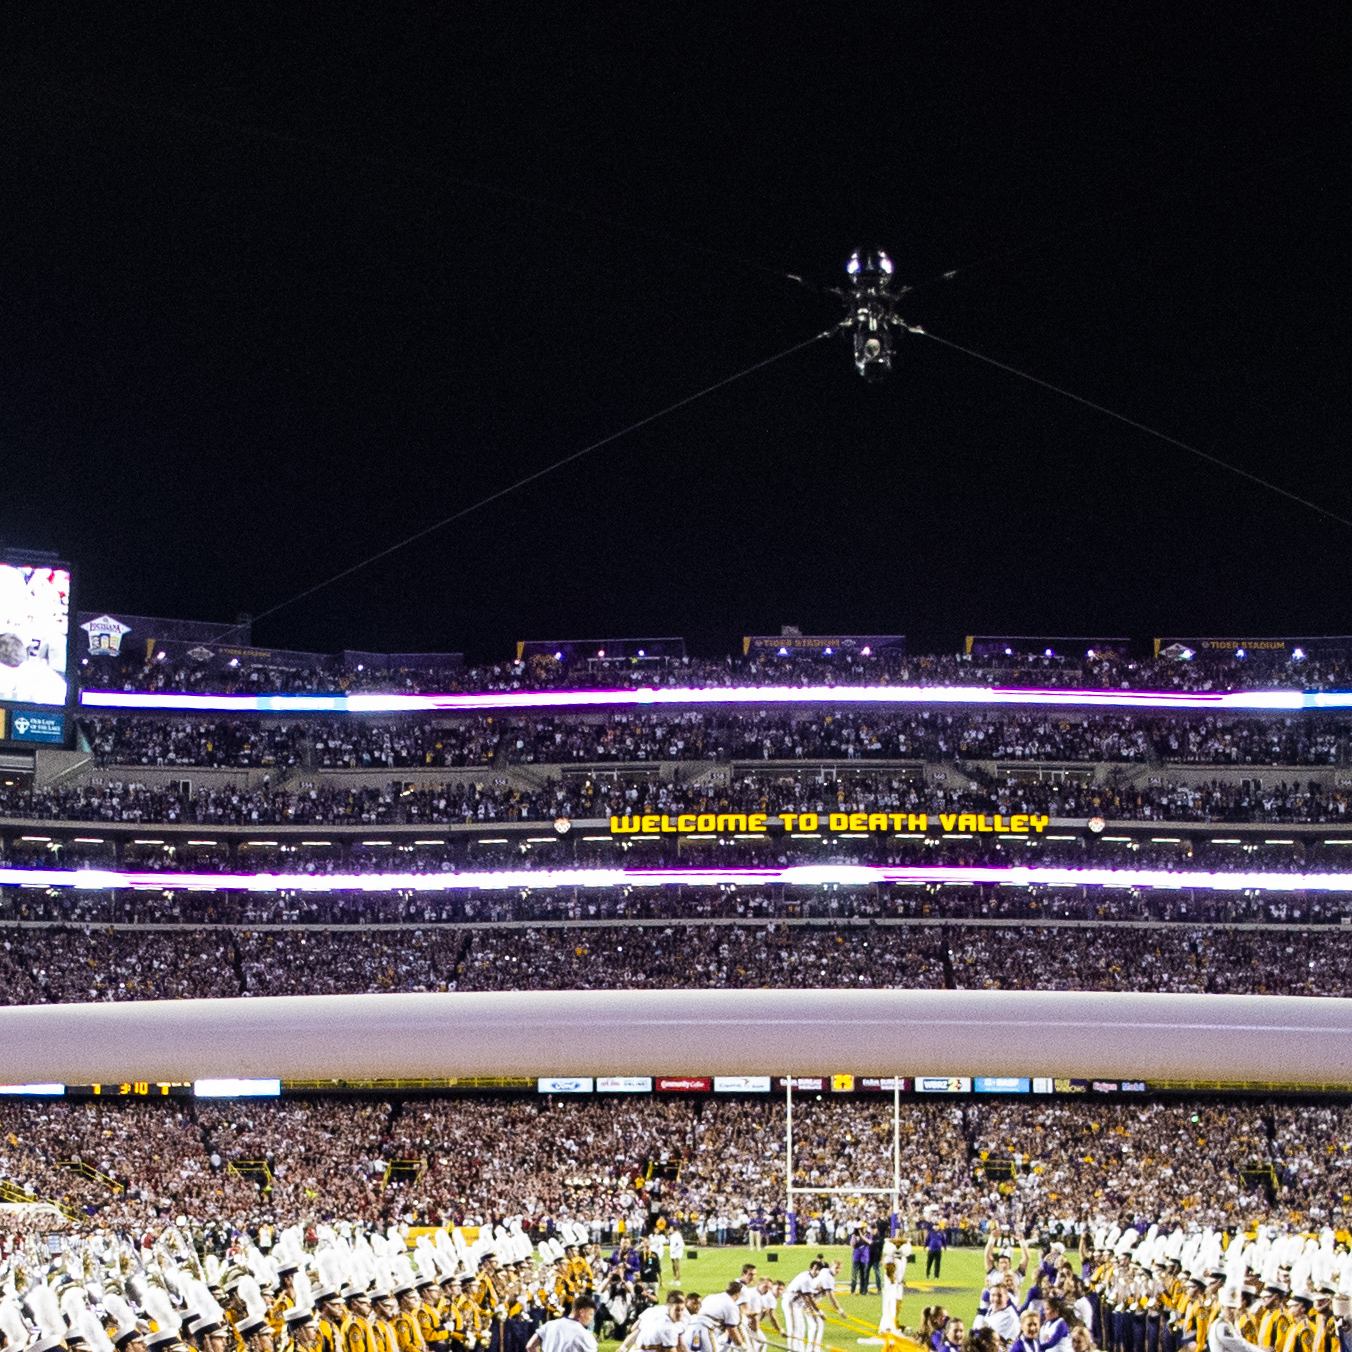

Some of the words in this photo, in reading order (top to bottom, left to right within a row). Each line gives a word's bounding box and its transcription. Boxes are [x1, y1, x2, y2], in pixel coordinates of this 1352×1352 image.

[610, 814, 767, 833] WELCOME
[779, 814, 818, 831] TO
[829, 813, 928, 831] DEATH
[939, 814, 1049, 832] VALLEY
